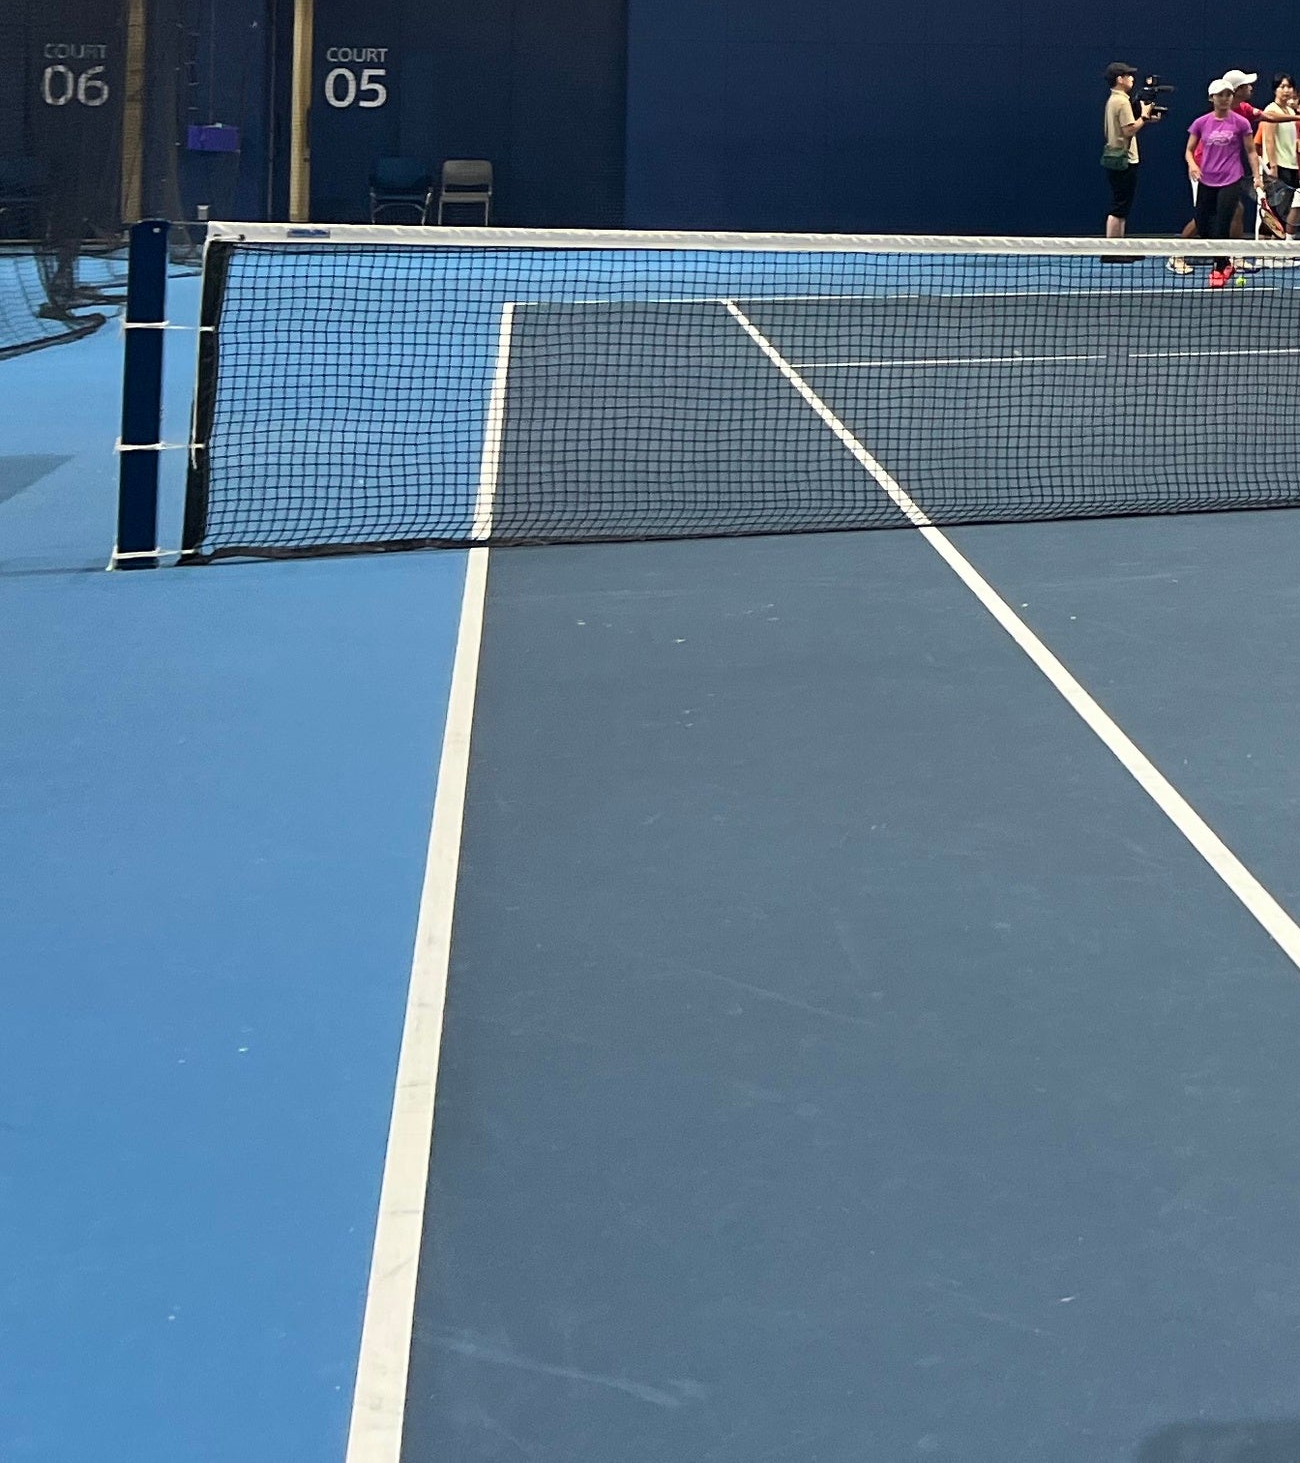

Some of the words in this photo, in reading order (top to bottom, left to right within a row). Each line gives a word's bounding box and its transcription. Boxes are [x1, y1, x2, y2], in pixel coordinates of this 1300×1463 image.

[326, 47, 388, 62] COURT
[44, 65, 108, 106] 06
[325, 68, 387, 108] 05
